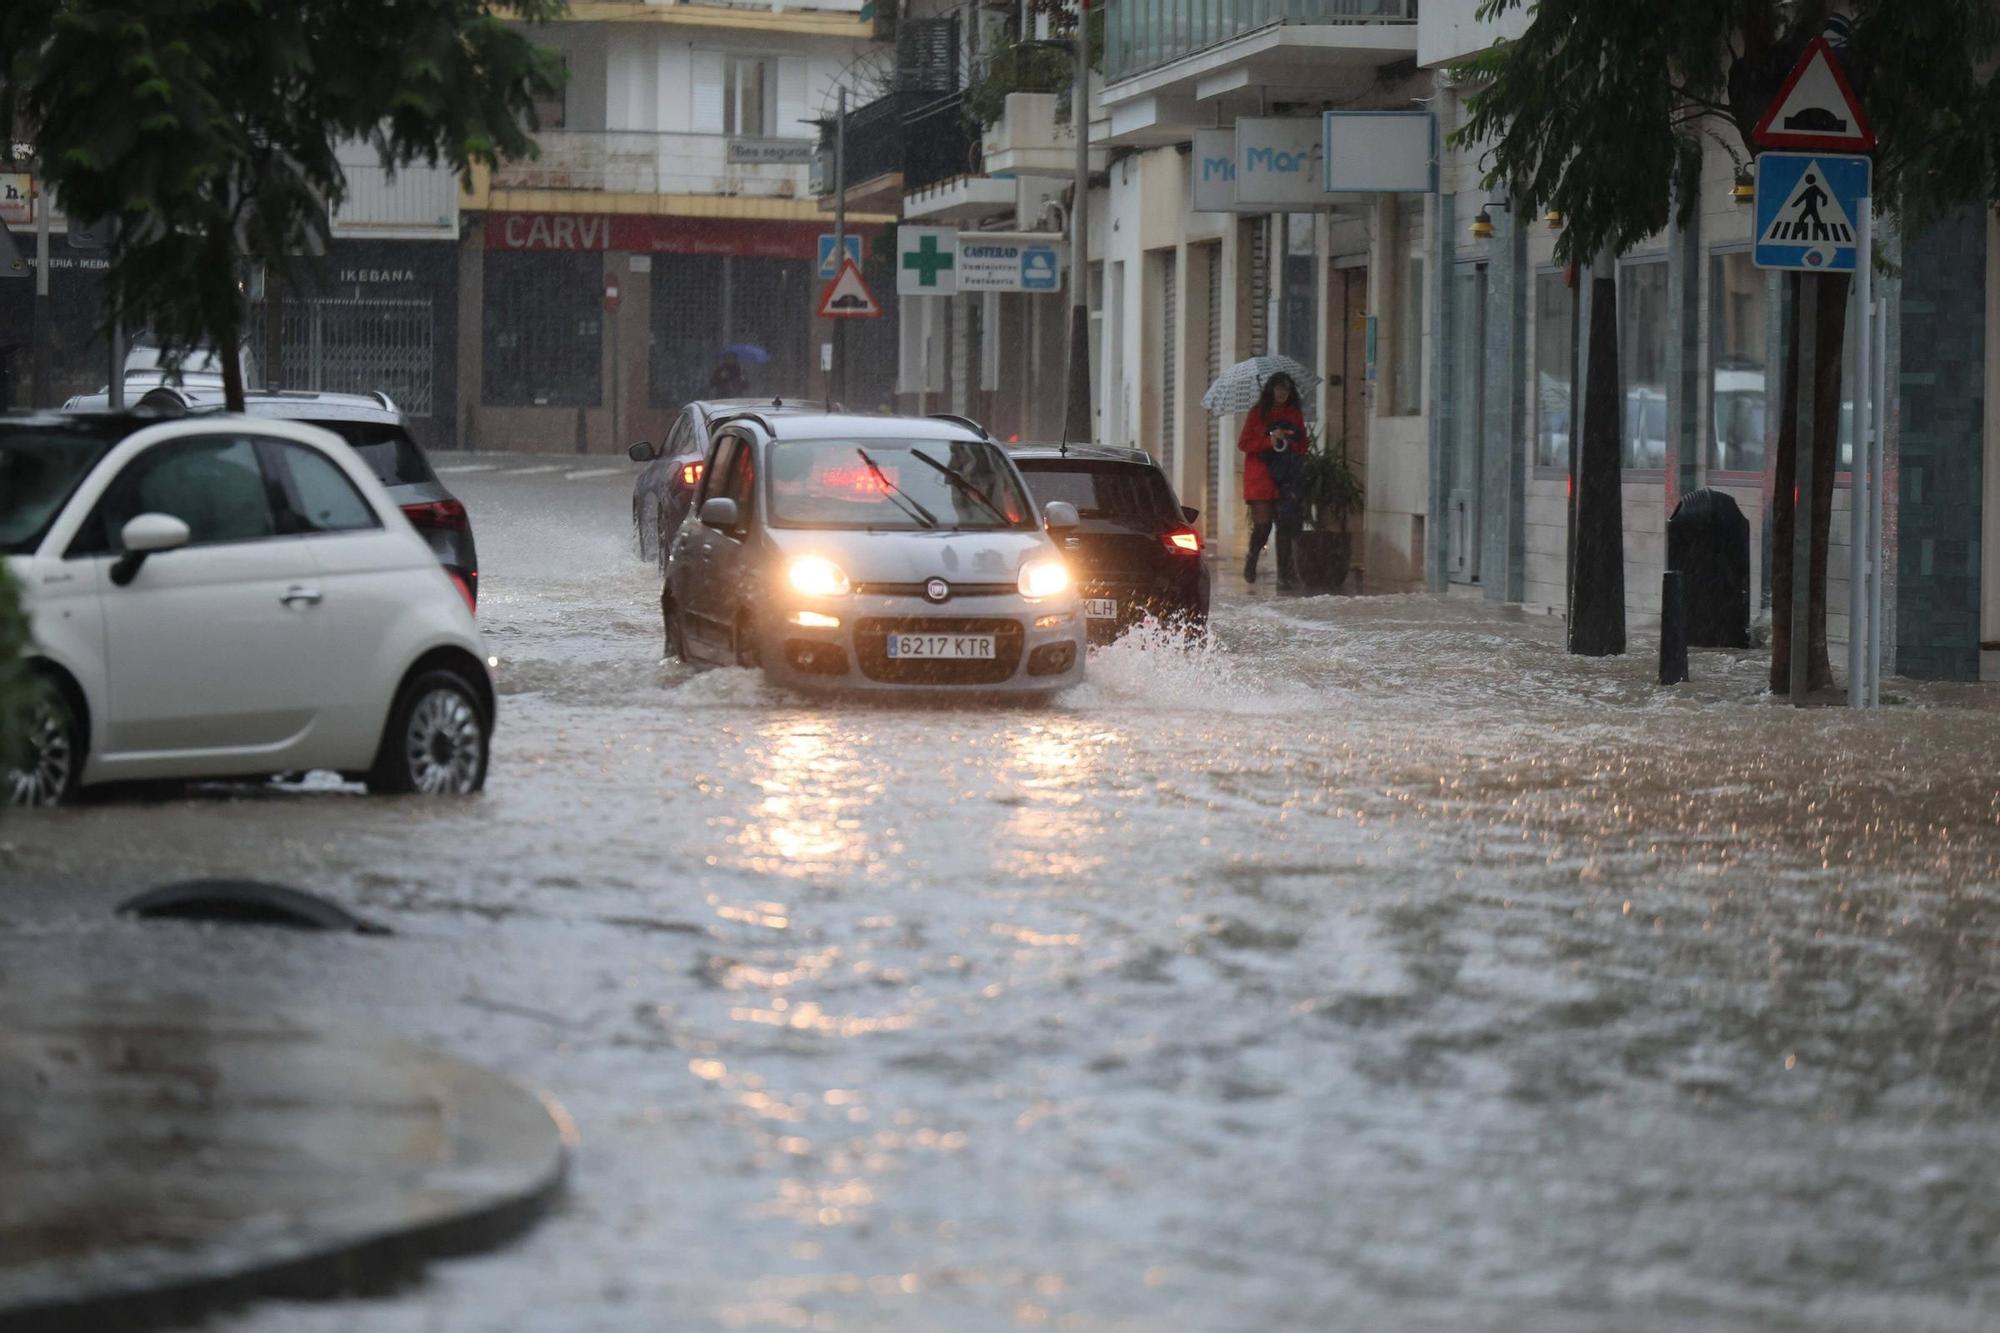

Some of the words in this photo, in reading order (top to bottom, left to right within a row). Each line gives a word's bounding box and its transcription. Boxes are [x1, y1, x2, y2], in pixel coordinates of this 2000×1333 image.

[505, 215, 610, 249] CARVI
[901, 636, 948, 656] 6217
[954, 637, 991, 657] KTR
